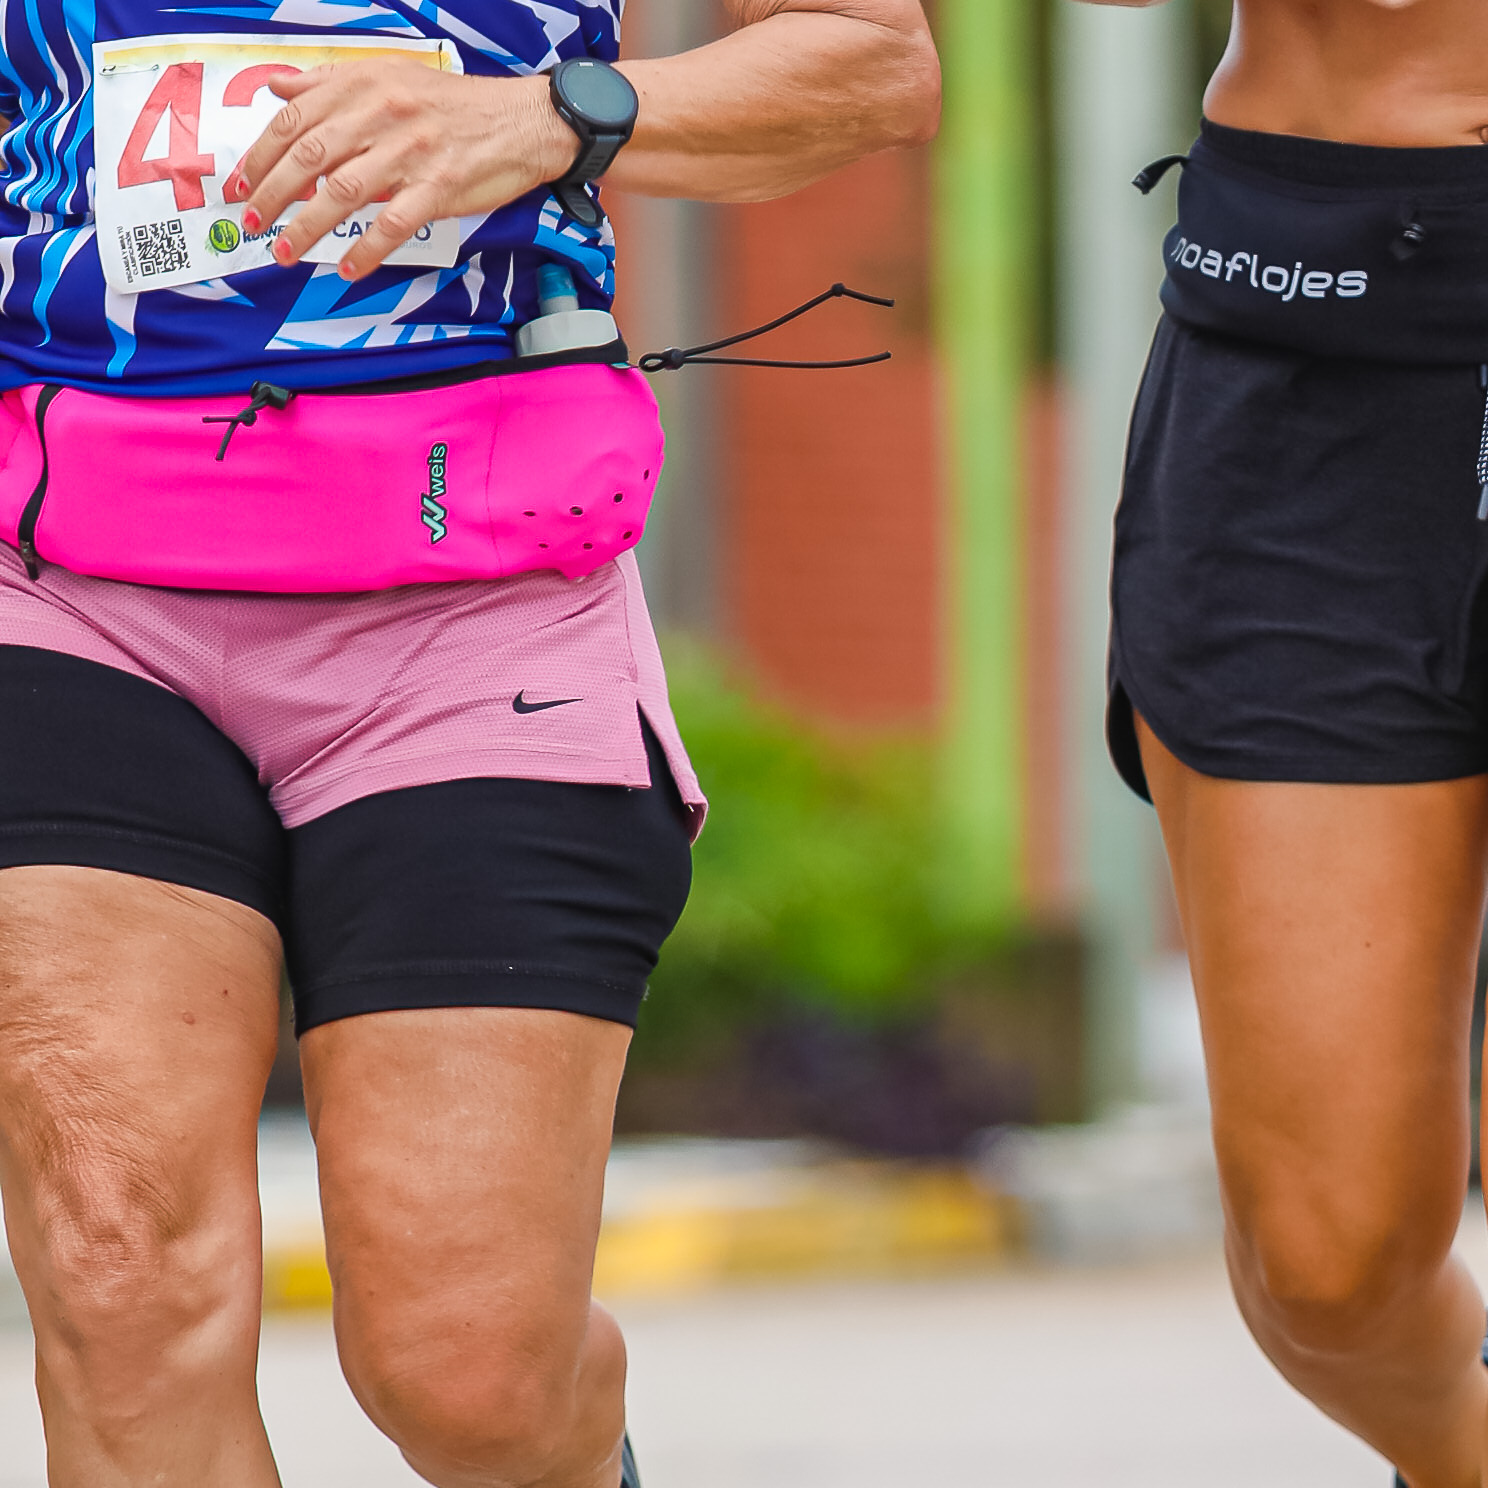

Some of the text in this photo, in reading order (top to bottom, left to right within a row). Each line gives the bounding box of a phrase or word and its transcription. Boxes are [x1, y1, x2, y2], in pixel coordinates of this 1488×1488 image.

[118, 62, 396, 212] 42
[1170, 237, 1368, 302] noaflojes
[428, 445, 446, 497] weis
